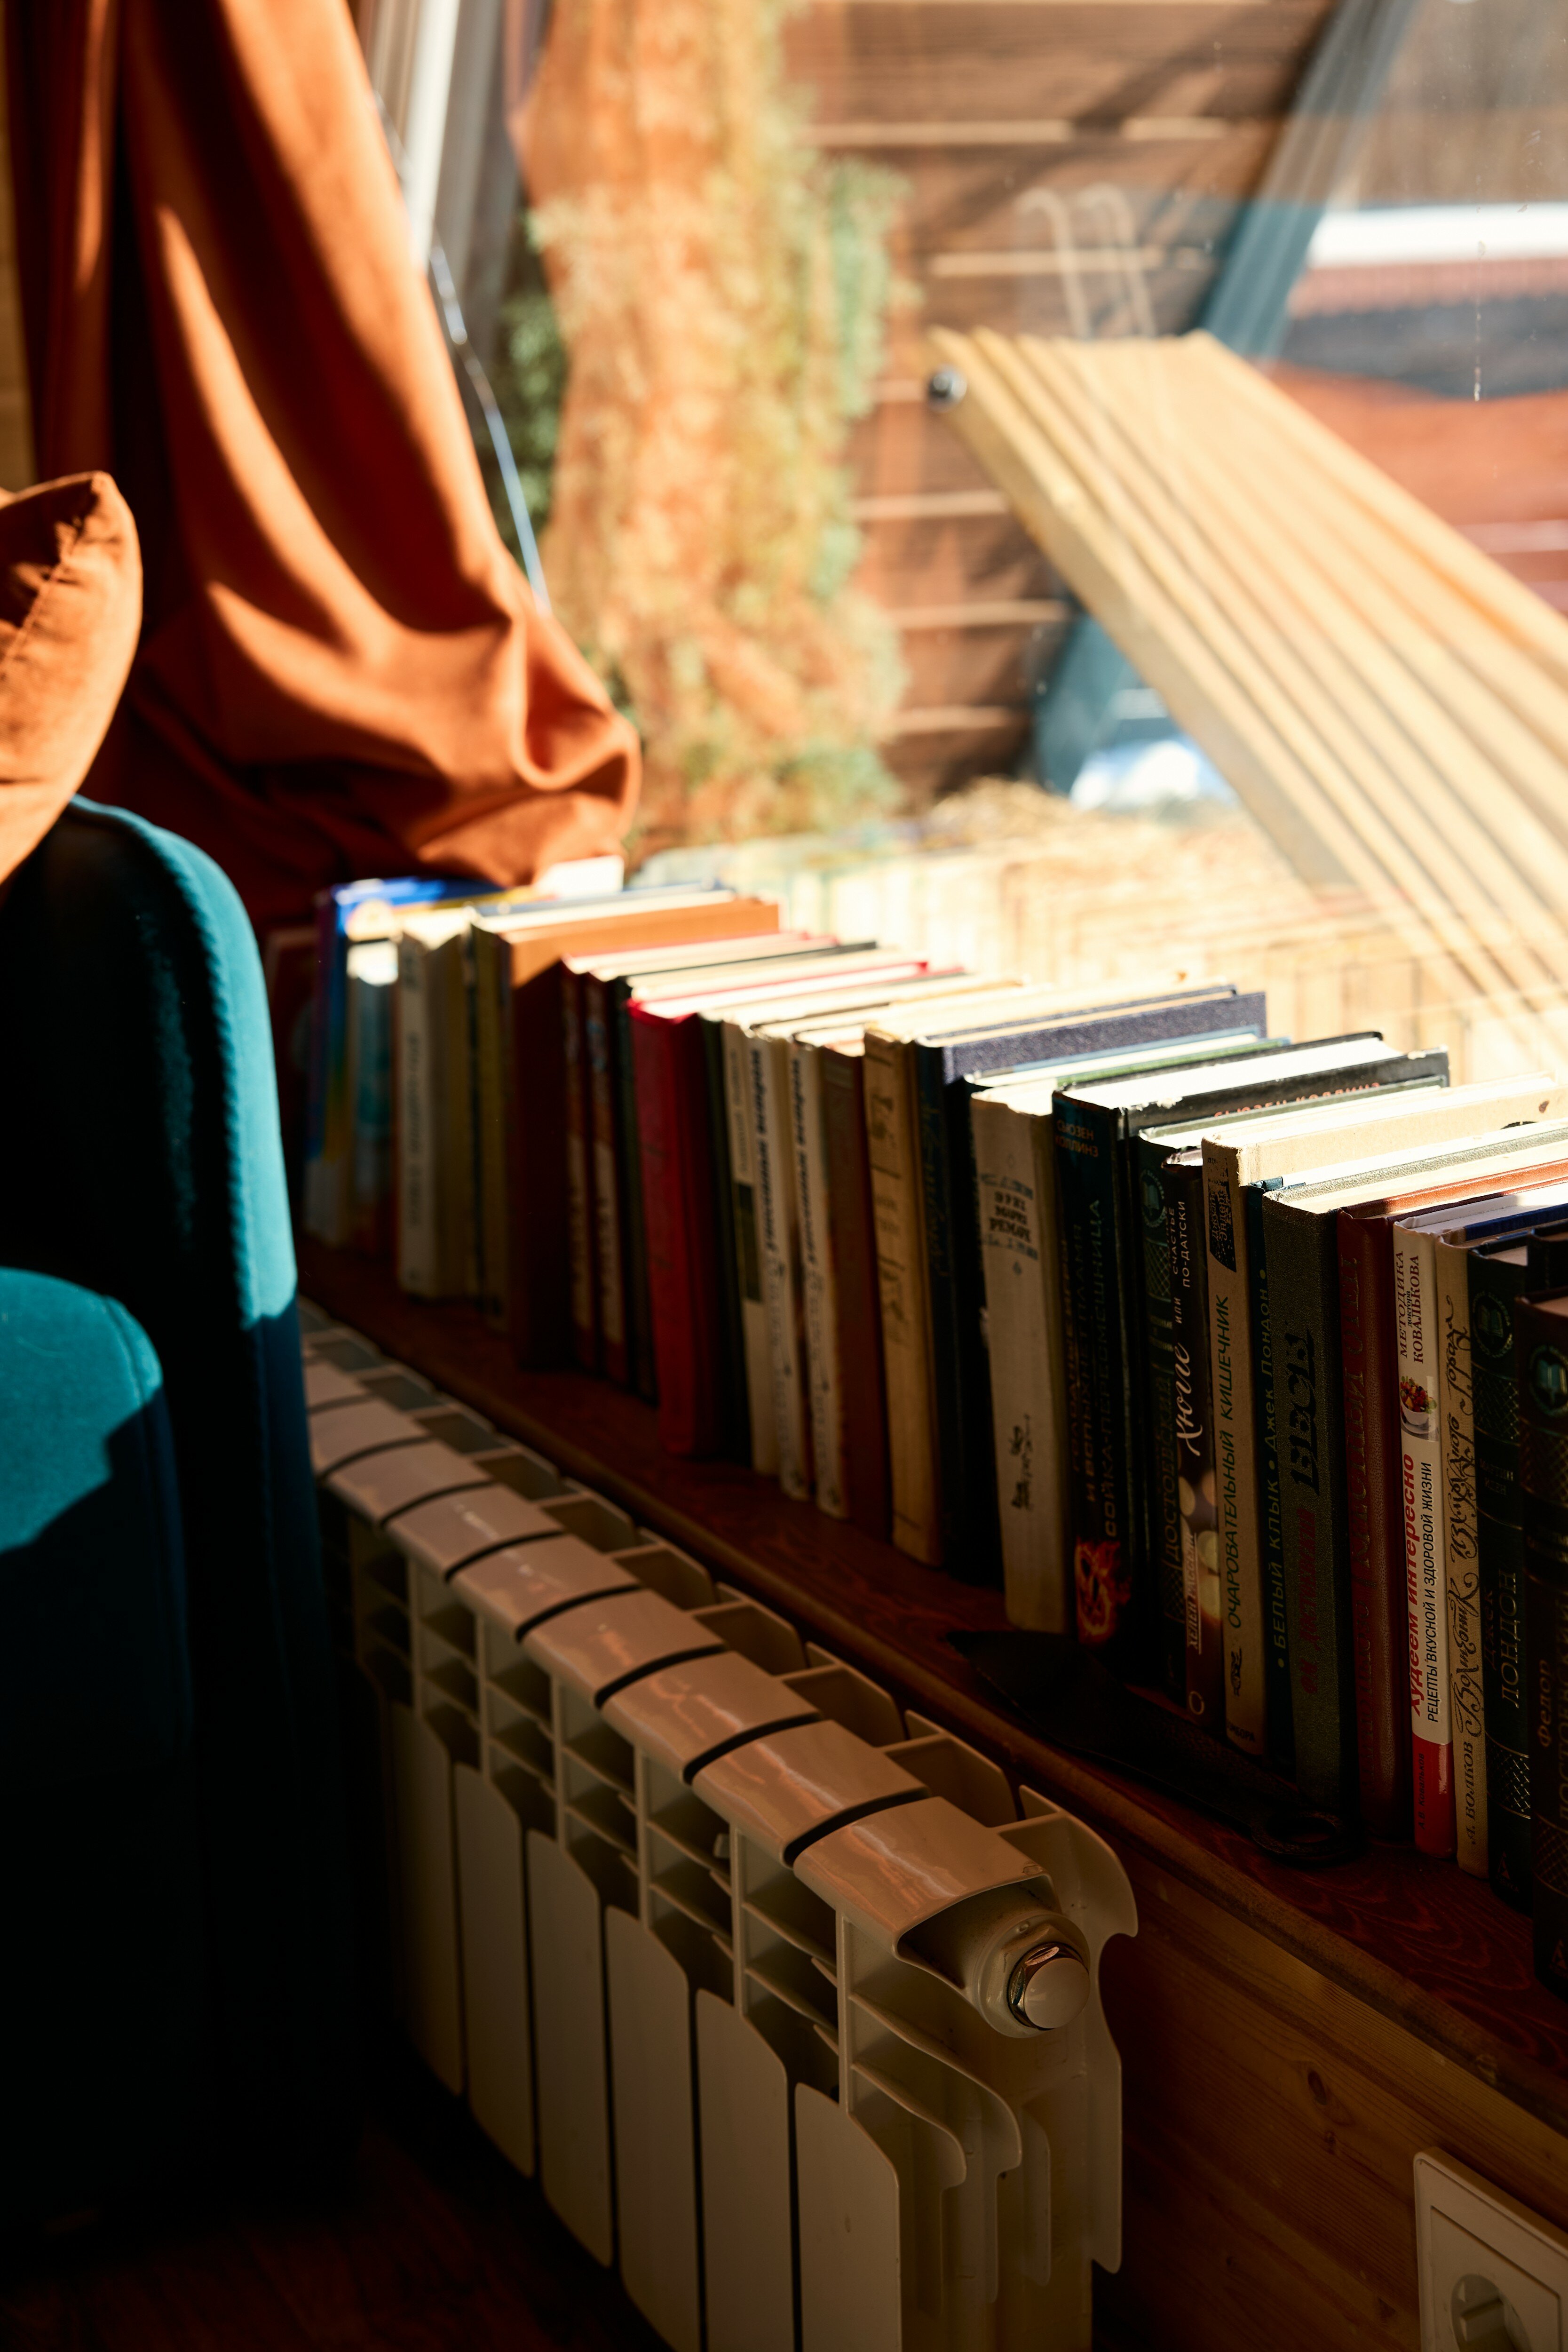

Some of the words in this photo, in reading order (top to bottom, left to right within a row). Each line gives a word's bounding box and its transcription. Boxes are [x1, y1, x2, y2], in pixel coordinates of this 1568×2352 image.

[1057, 1119, 1095, 1142] СЬЮЗЕН
[1169, 1207, 1179, 1275] СЧАСТЬЕ
[1178, 1200, 1191, 1288] ПО-ДАТСКИ
[1174, 1296, 1183, 1325] или
[1260, 1288, 1273, 1377] Лондон
[1341, 1253, 1363, 1356] ОТЕЦ
[1395, 1251, 1408, 1359] МЕТОДИКА
[1410, 1255, 1424, 1364] КОВАЛЬКОВА
[1089, 1199, 1117, 1538] СОЙКА-ПЕРЕСМЕШНИЦА
[1216, 1295, 1234, 1421] КИШЕЧНИК
[1265, 1388, 1278, 1453] Джек
[1285, 1325, 1320, 1495] БЕСЫ
[1345, 1367, 1370, 1569] КРЕСТНЫЙ
[1420, 1462, 1433, 1512] ЖИЗНИ
[1221, 1430, 1242, 1629] ОЧАРОВАТЕЛЬНЫЙ
[1267, 1479, 1283, 1551] КЛЫК
[1402, 1454, 1420, 1605] интересно
[1420, 1512, 1437, 1586] ЗДОРОВОЙ
[1267, 1558, 1287, 1651] БЕЛЫЙ
[1297, 1507, 1321, 1650] ДОСТОЕВСКИЙ
[1421, 1600, 1439, 1662] ВКУСНОЙ
[1499, 1569, 1521, 1709] ЛОНДОН
[1423, 1663, 1439, 1723] РЕЦЕПТЫ
[1537, 1658, 1552, 1748] Федор
[1417, 1753, 1425, 1808] Ковальков
[1463, 1741, 1476, 1819] ВОЛКОВ
